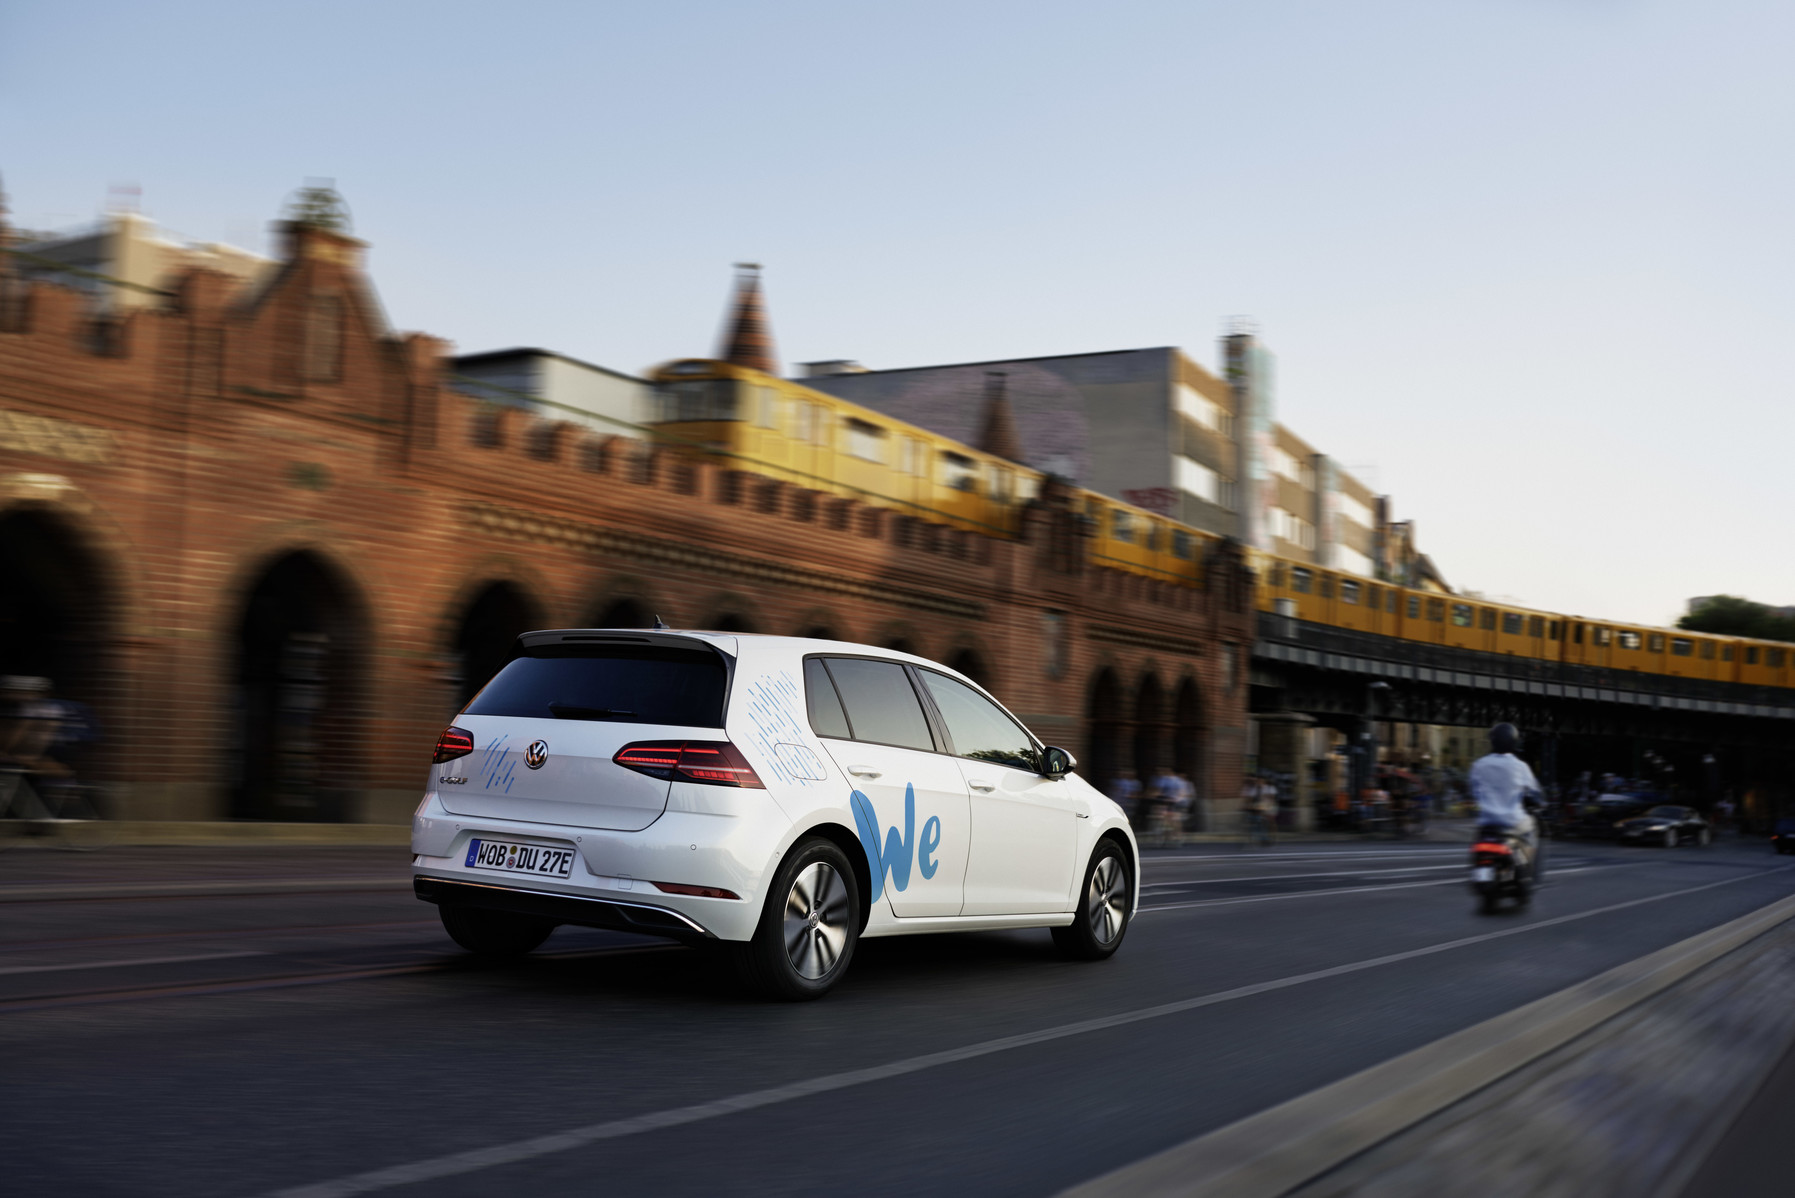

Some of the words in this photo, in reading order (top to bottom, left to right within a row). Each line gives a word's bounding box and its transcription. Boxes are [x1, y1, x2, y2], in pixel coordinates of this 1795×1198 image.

[477, 843, 507, 866] WOB
[516, 847, 539, 870] DU
[539, 850, 572, 874] 27E
[849, 781, 941, 904] We
